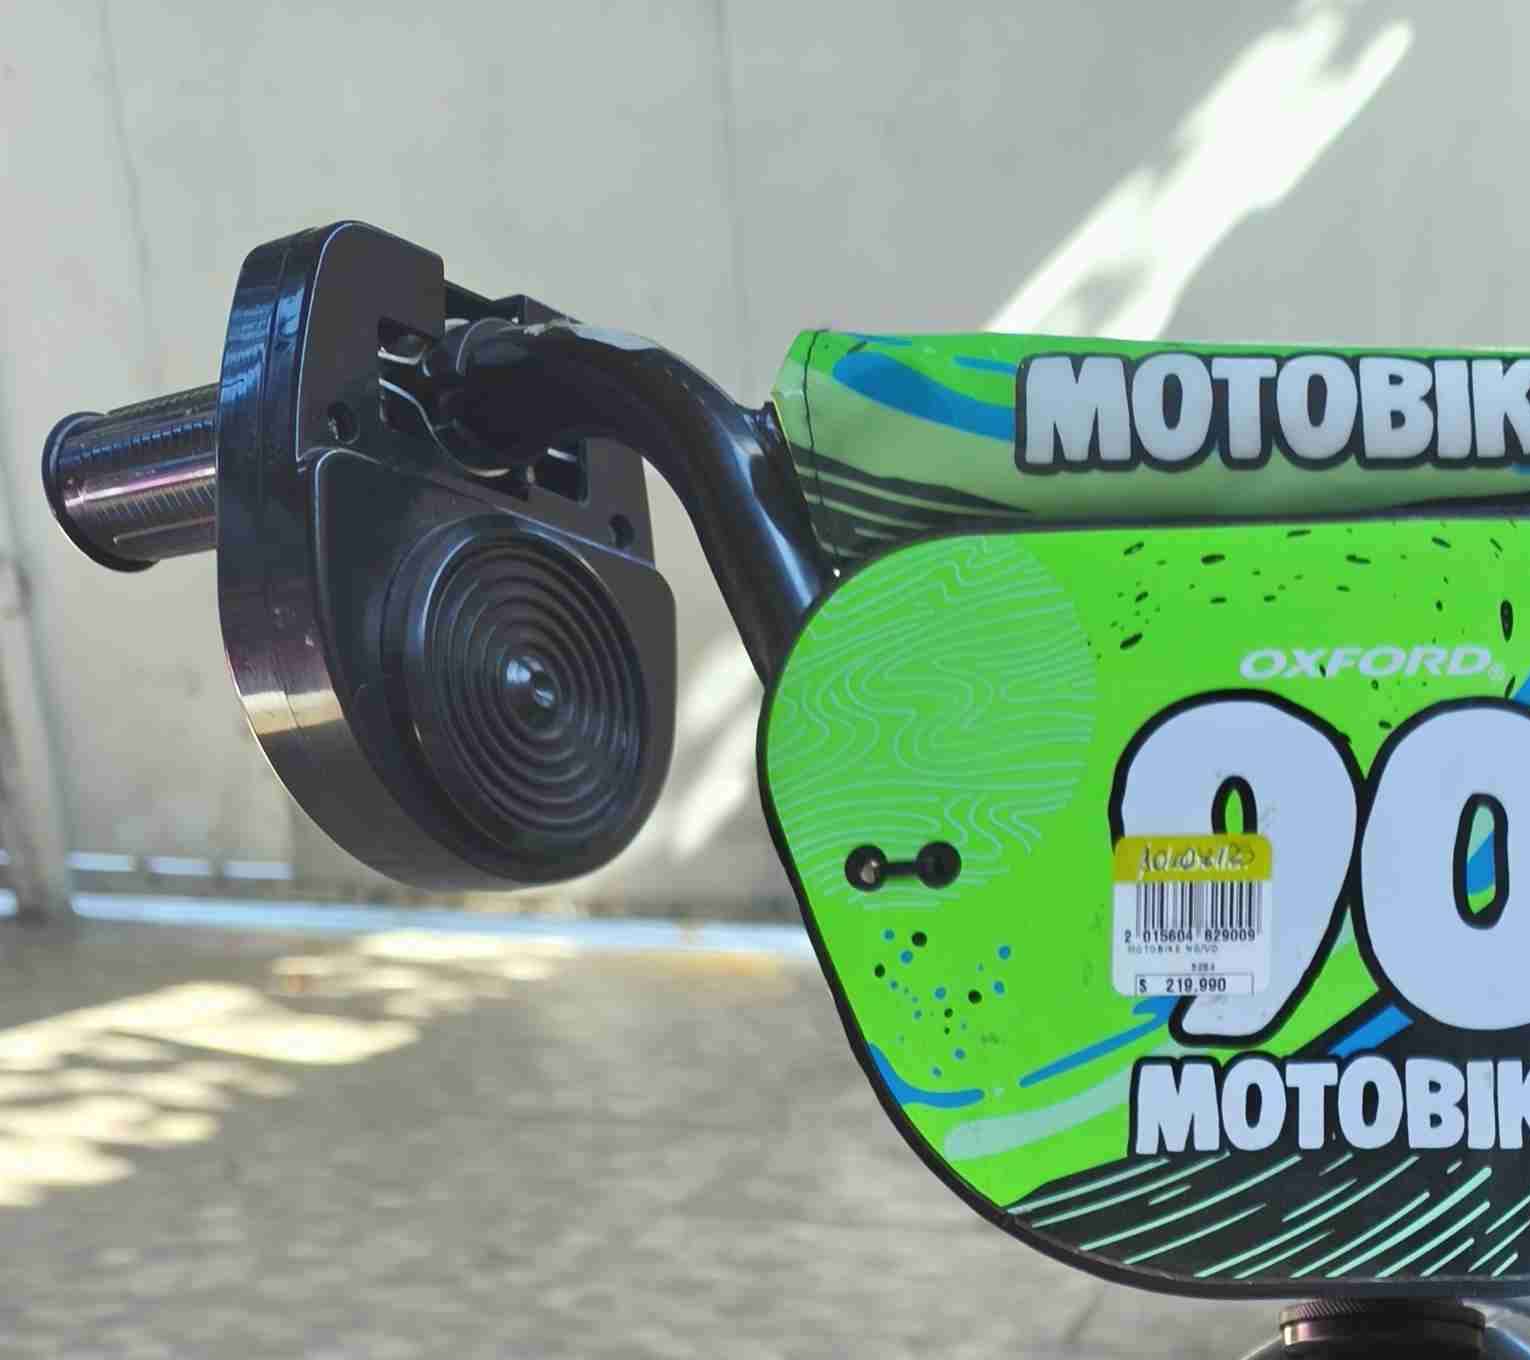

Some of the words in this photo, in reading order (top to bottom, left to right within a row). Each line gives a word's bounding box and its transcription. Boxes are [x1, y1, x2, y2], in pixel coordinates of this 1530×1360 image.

[1239, 644, 1491, 681] OXFORD
[1124, 930, 1132, 944] 2
[1143, 929, 1193, 943] 015604
[1139, 978, 1148, 993] $
[1166, 977, 1227, 993] 219.990
